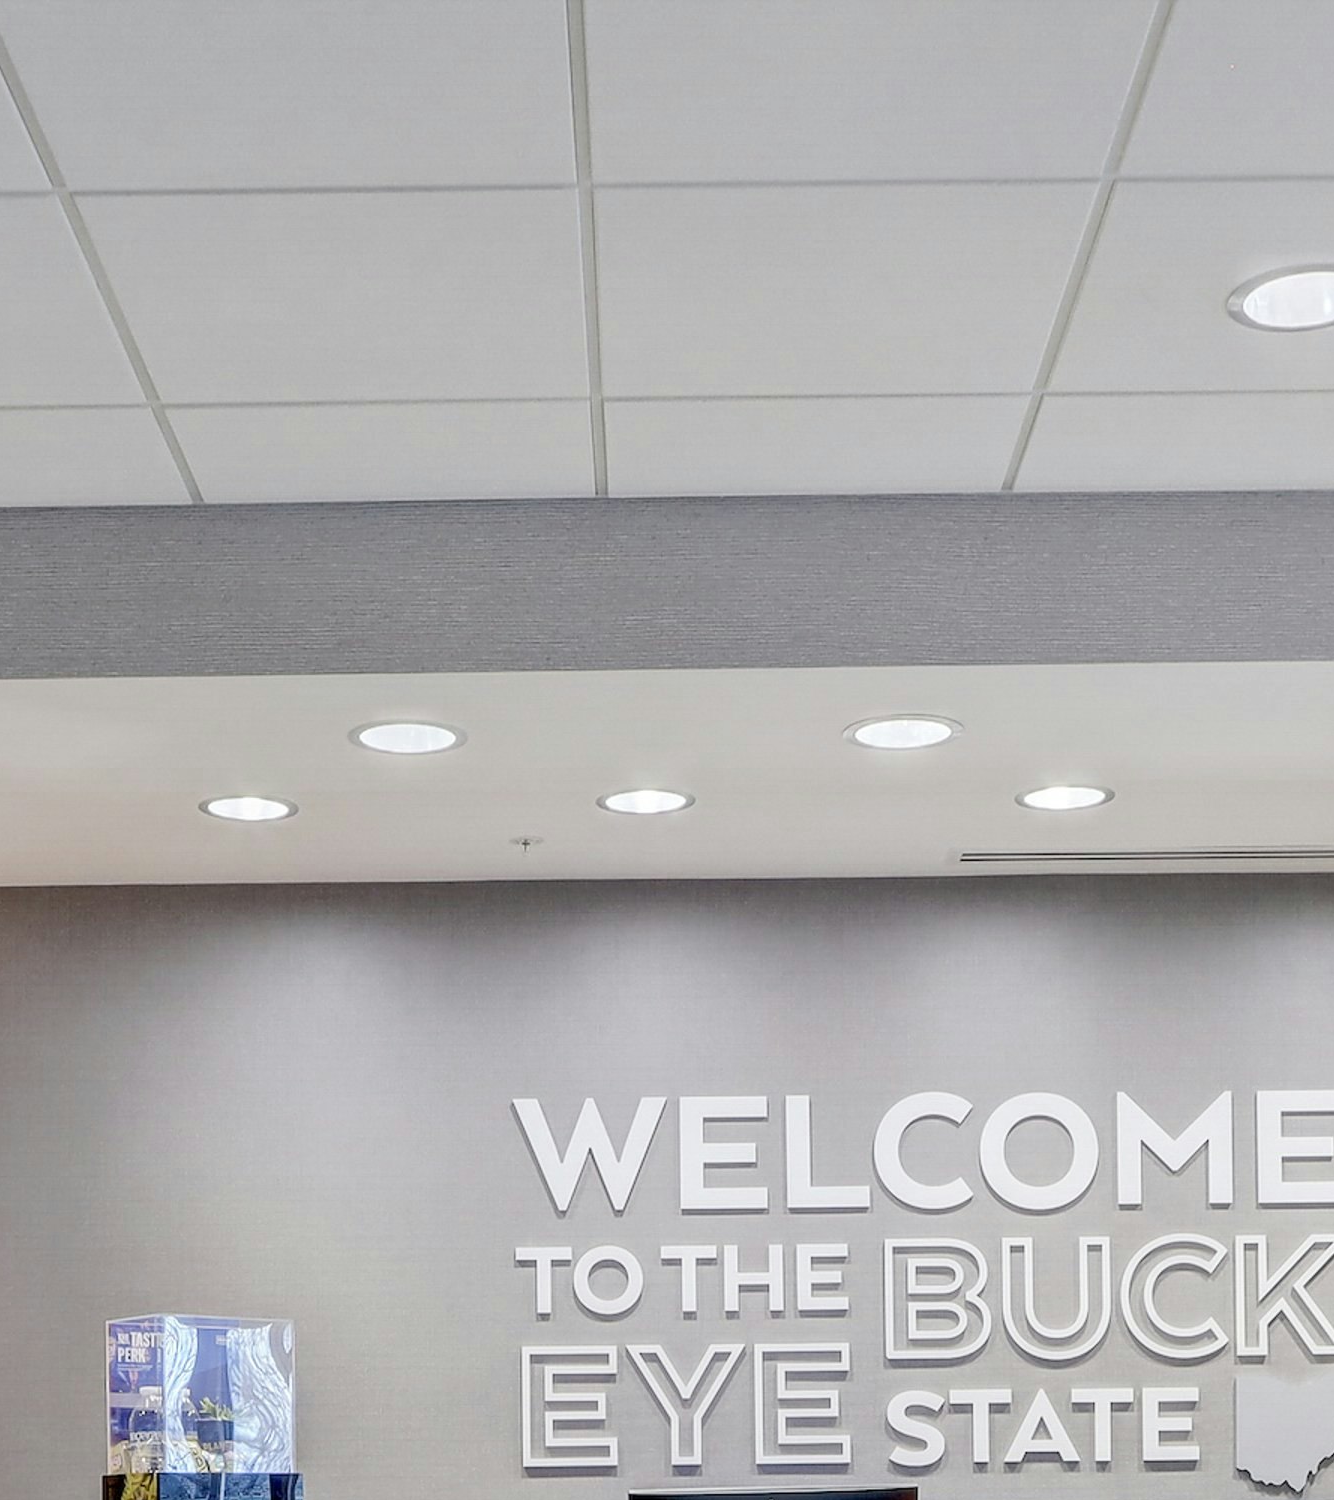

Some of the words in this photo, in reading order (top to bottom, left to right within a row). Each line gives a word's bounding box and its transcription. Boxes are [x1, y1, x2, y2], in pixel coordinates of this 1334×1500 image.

[514, 1245, 644, 1316] TO
[660, 1243, 850, 1313] THE
[520, 1342, 852, 1469] EYE
[885, 1387, 1201, 1467] STATE
